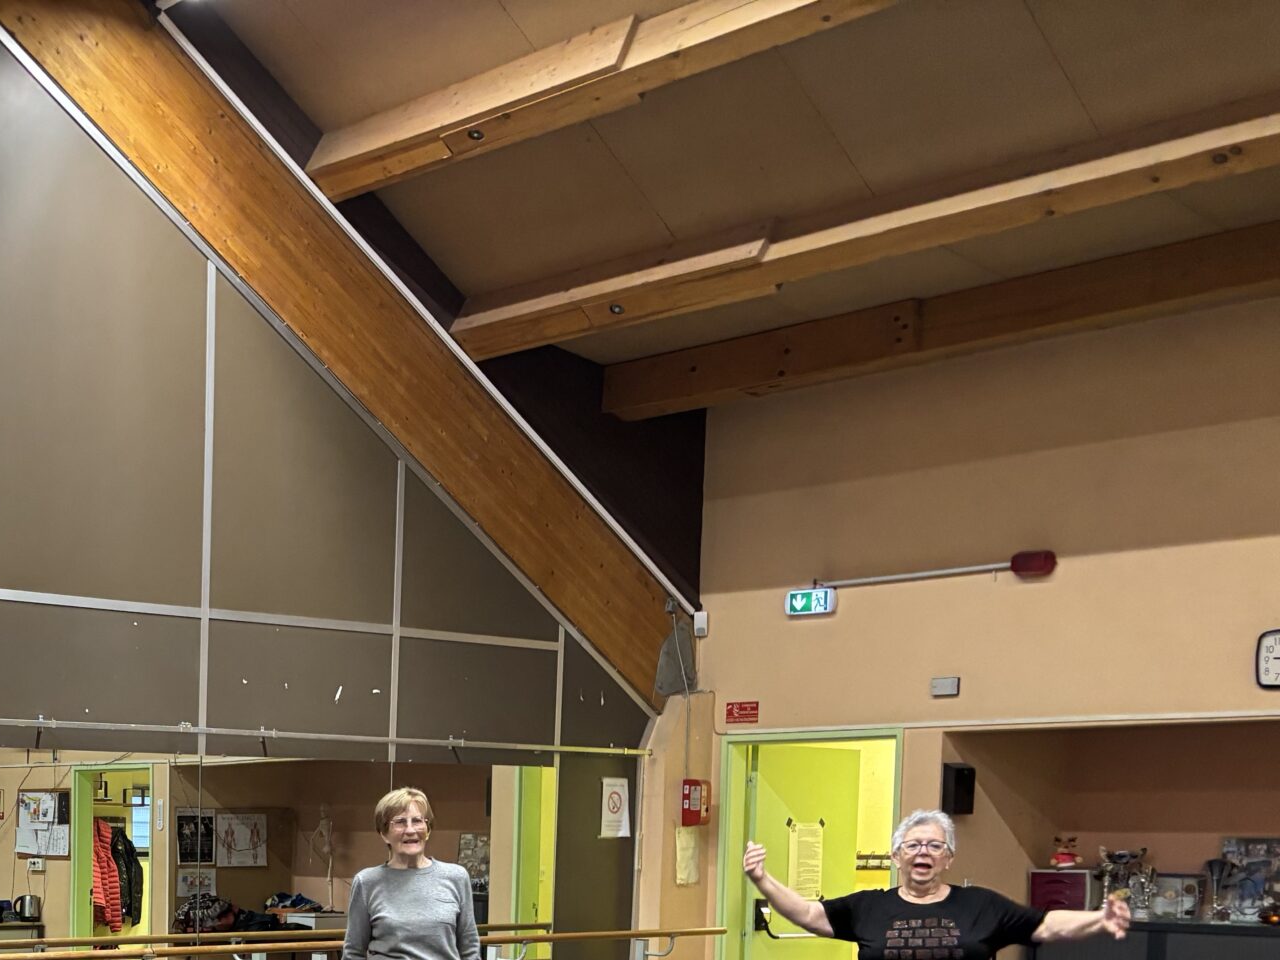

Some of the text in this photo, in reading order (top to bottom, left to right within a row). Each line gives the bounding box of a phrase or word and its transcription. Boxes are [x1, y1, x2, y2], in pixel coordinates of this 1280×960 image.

[1265, 645, 1274, 654] 10
[1264, 656, 1269, 665] 9
[1264, 667, 1269, 676] 8
[1274, 672, 1280, 681] 7
